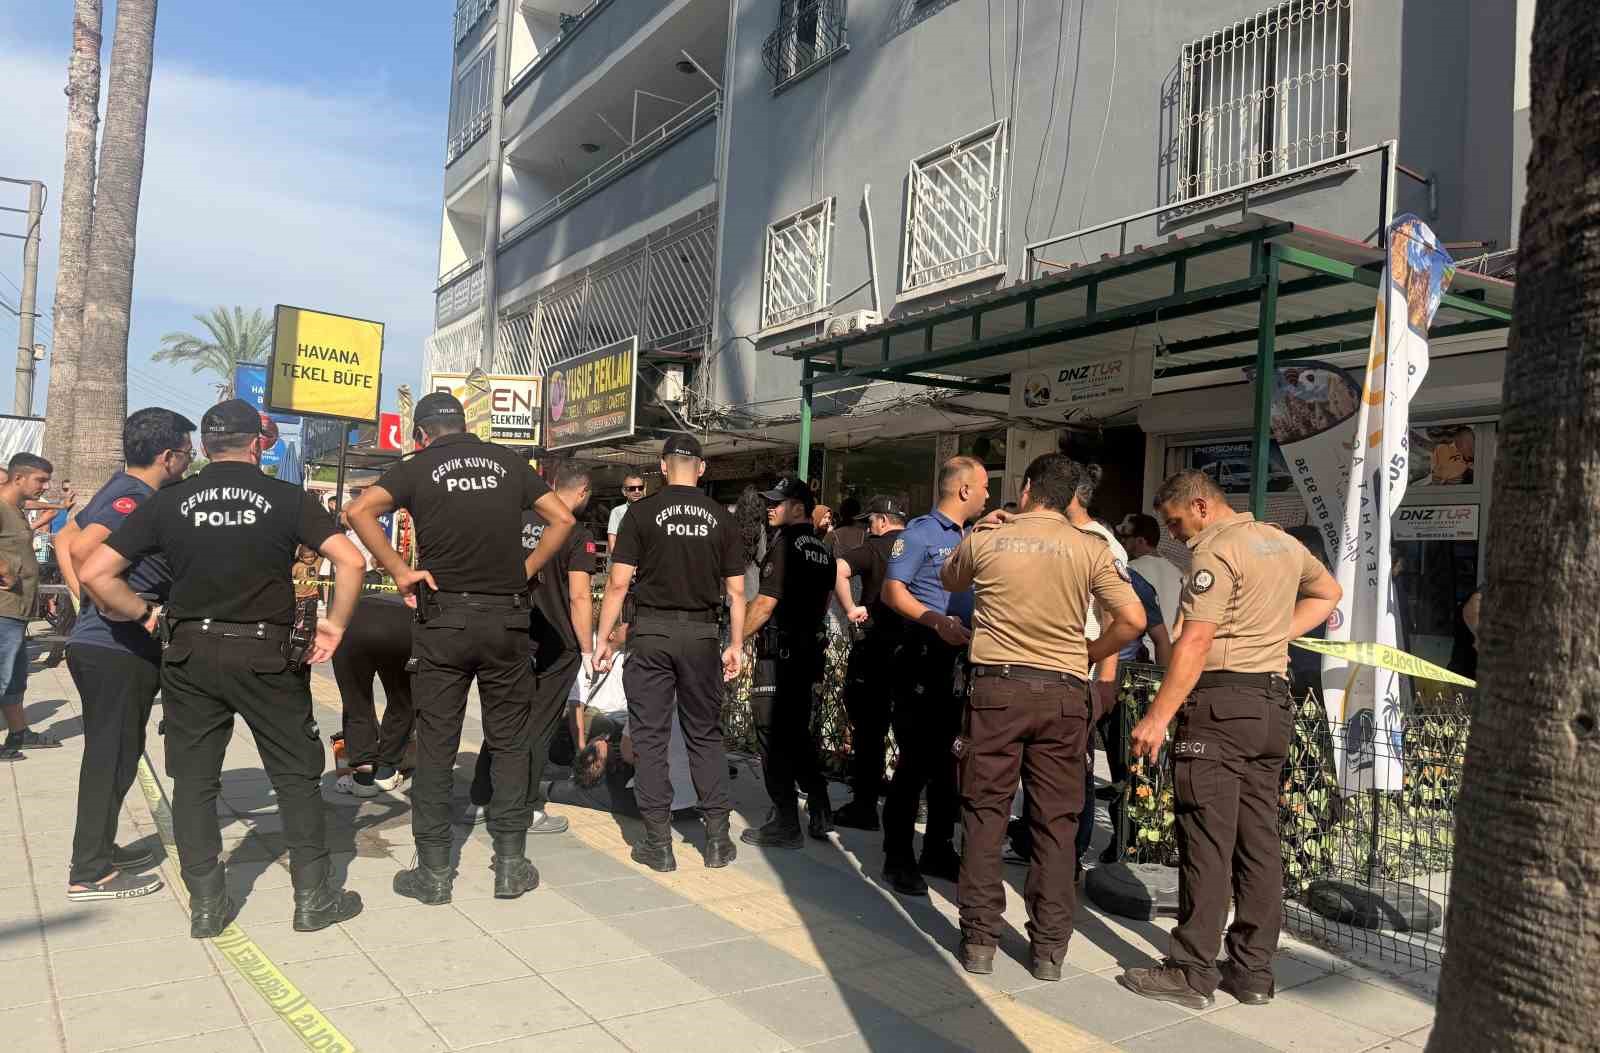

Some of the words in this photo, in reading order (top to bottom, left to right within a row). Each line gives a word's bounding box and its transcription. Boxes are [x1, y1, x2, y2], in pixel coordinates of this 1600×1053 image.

[297, 343, 360, 366] HAVANA
[281, 364, 328, 384] TEKEL
[333, 369, 374, 389] BÜFE
[566, 362, 593, 401] YUSUF
[594, 350, 631, 395] REKLAM
[464, 457, 507, 478] KUVVET
[222, 487, 272, 514] KUVVET
[684, 505, 718, 528] KUVVET
